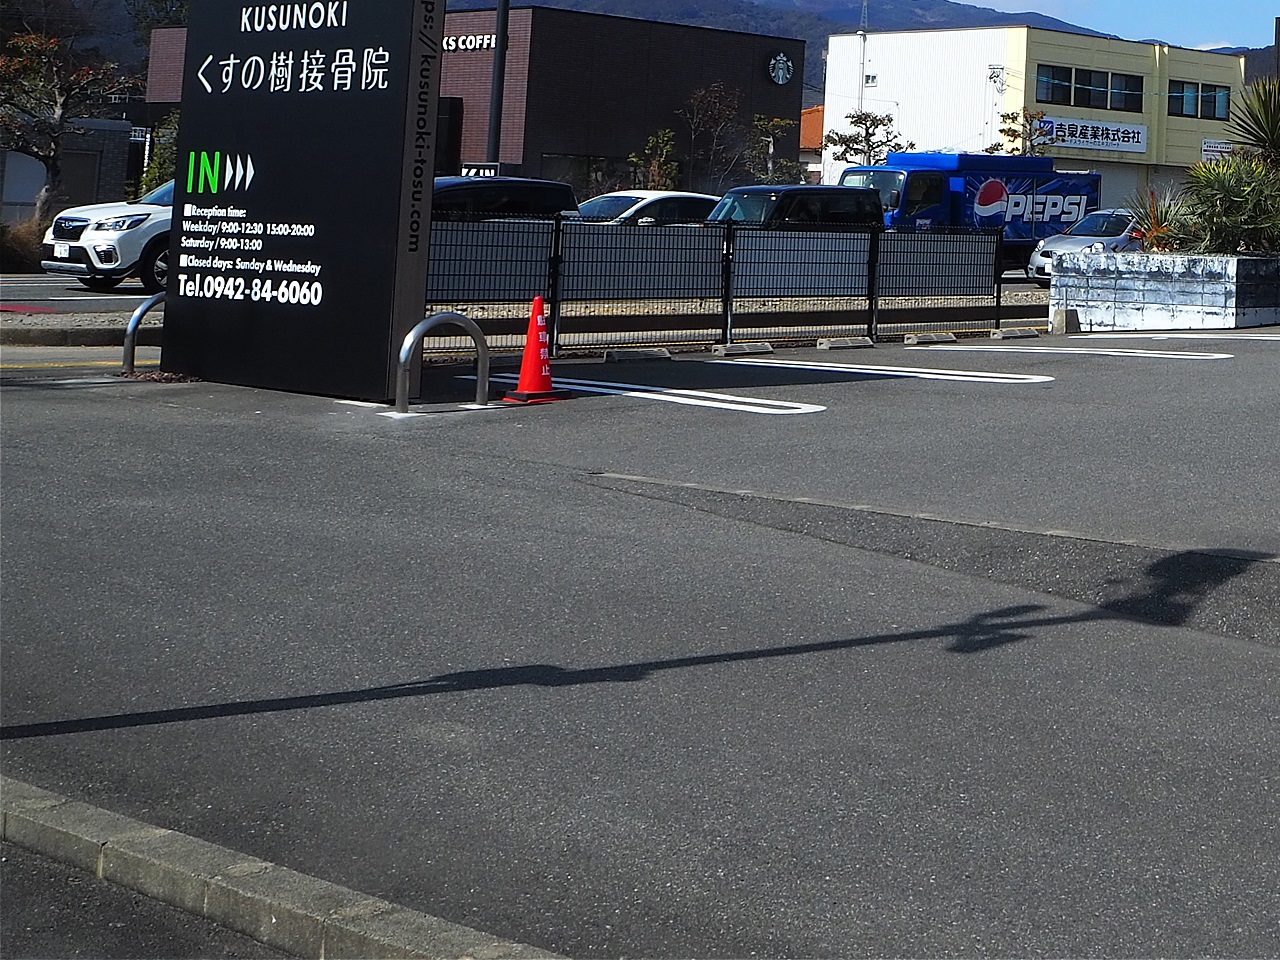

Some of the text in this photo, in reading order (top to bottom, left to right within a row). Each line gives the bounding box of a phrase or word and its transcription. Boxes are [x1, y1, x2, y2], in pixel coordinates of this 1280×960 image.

[240, 0, 348, 32] KUSUNOKI
[197, 46, 390, 93] くすの樹接骨院
[186, 151, 221, 194] IN
[190, 204, 247, 220] Reception time:
[1003, 194, 1088, 222] PEPSI
[266, 223, 315, 237] 15:00-20:00
[187, 254, 322, 276] Closed days: Sunday & Wednesday
